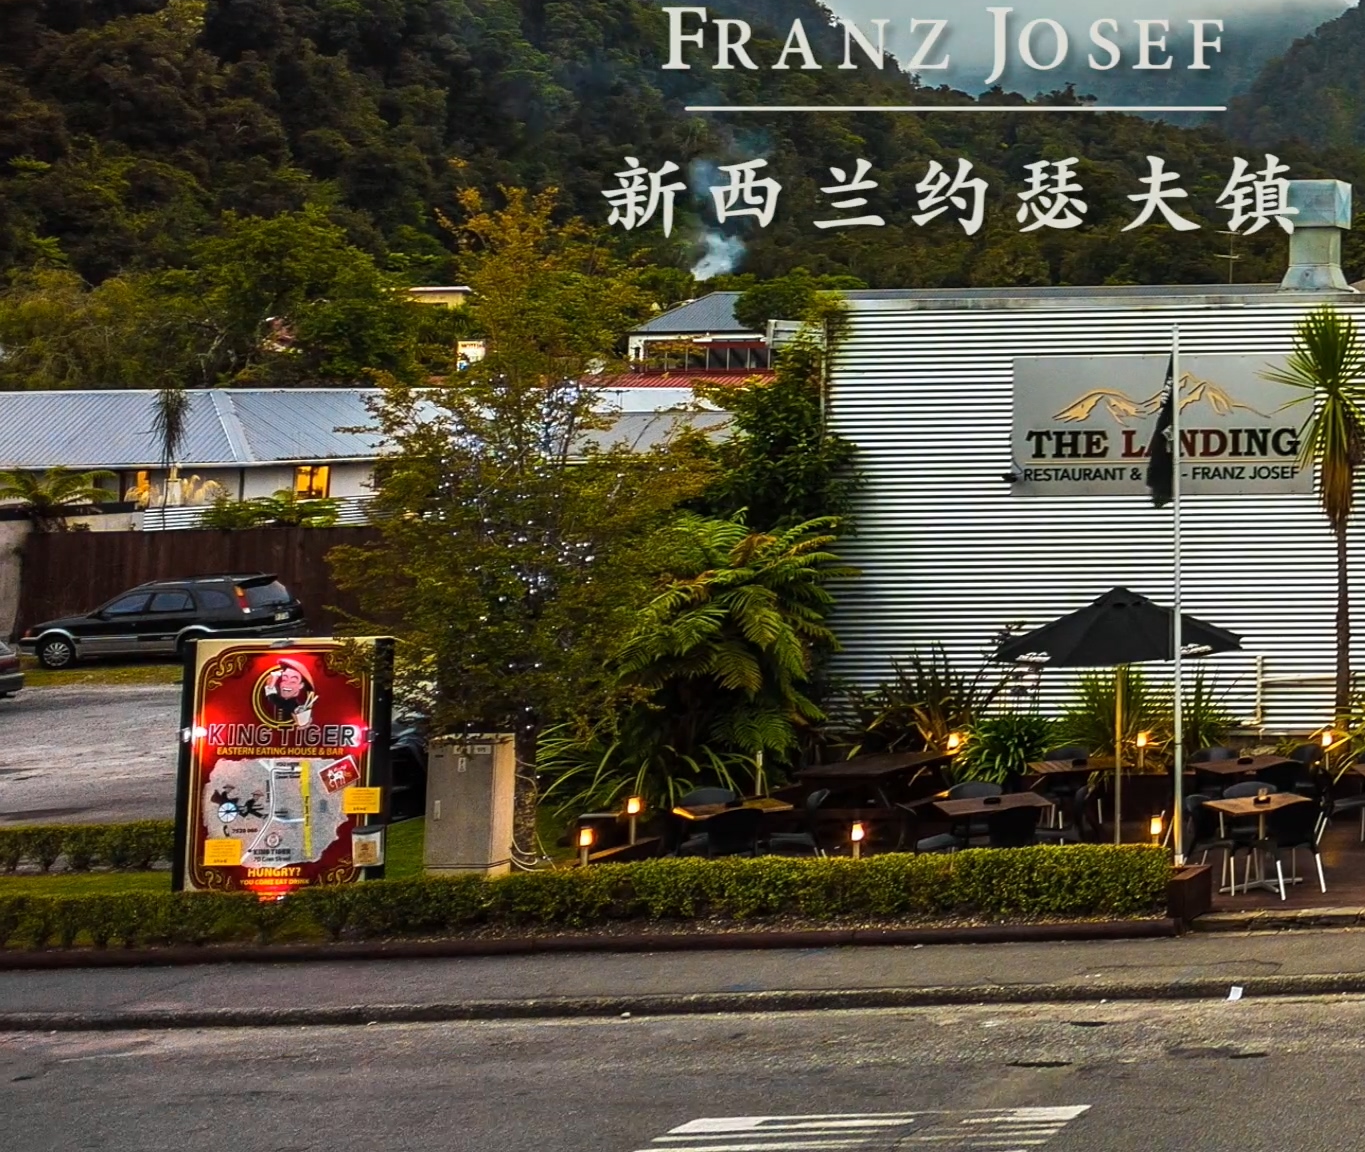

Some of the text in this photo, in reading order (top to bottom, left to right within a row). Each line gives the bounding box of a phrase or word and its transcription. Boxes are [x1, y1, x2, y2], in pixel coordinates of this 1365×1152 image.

[1026, 427, 1302, 459] THE LNDING
[1023, 466, 1127, 482] RESTAURANT
[1130, 467, 1142, 481] &
[1192, 466, 1246, 481] FRANZ
[1249, 465, 1301, 480] JOSEF
[208, 723, 357, 746] KING TIGER
[217, 747, 255, 756] EASTERN
[256, 747, 286, 756] EATING
[287, 747, 318, 756] HOUSE
[247, 867, 301, 877] HUNGRY?
